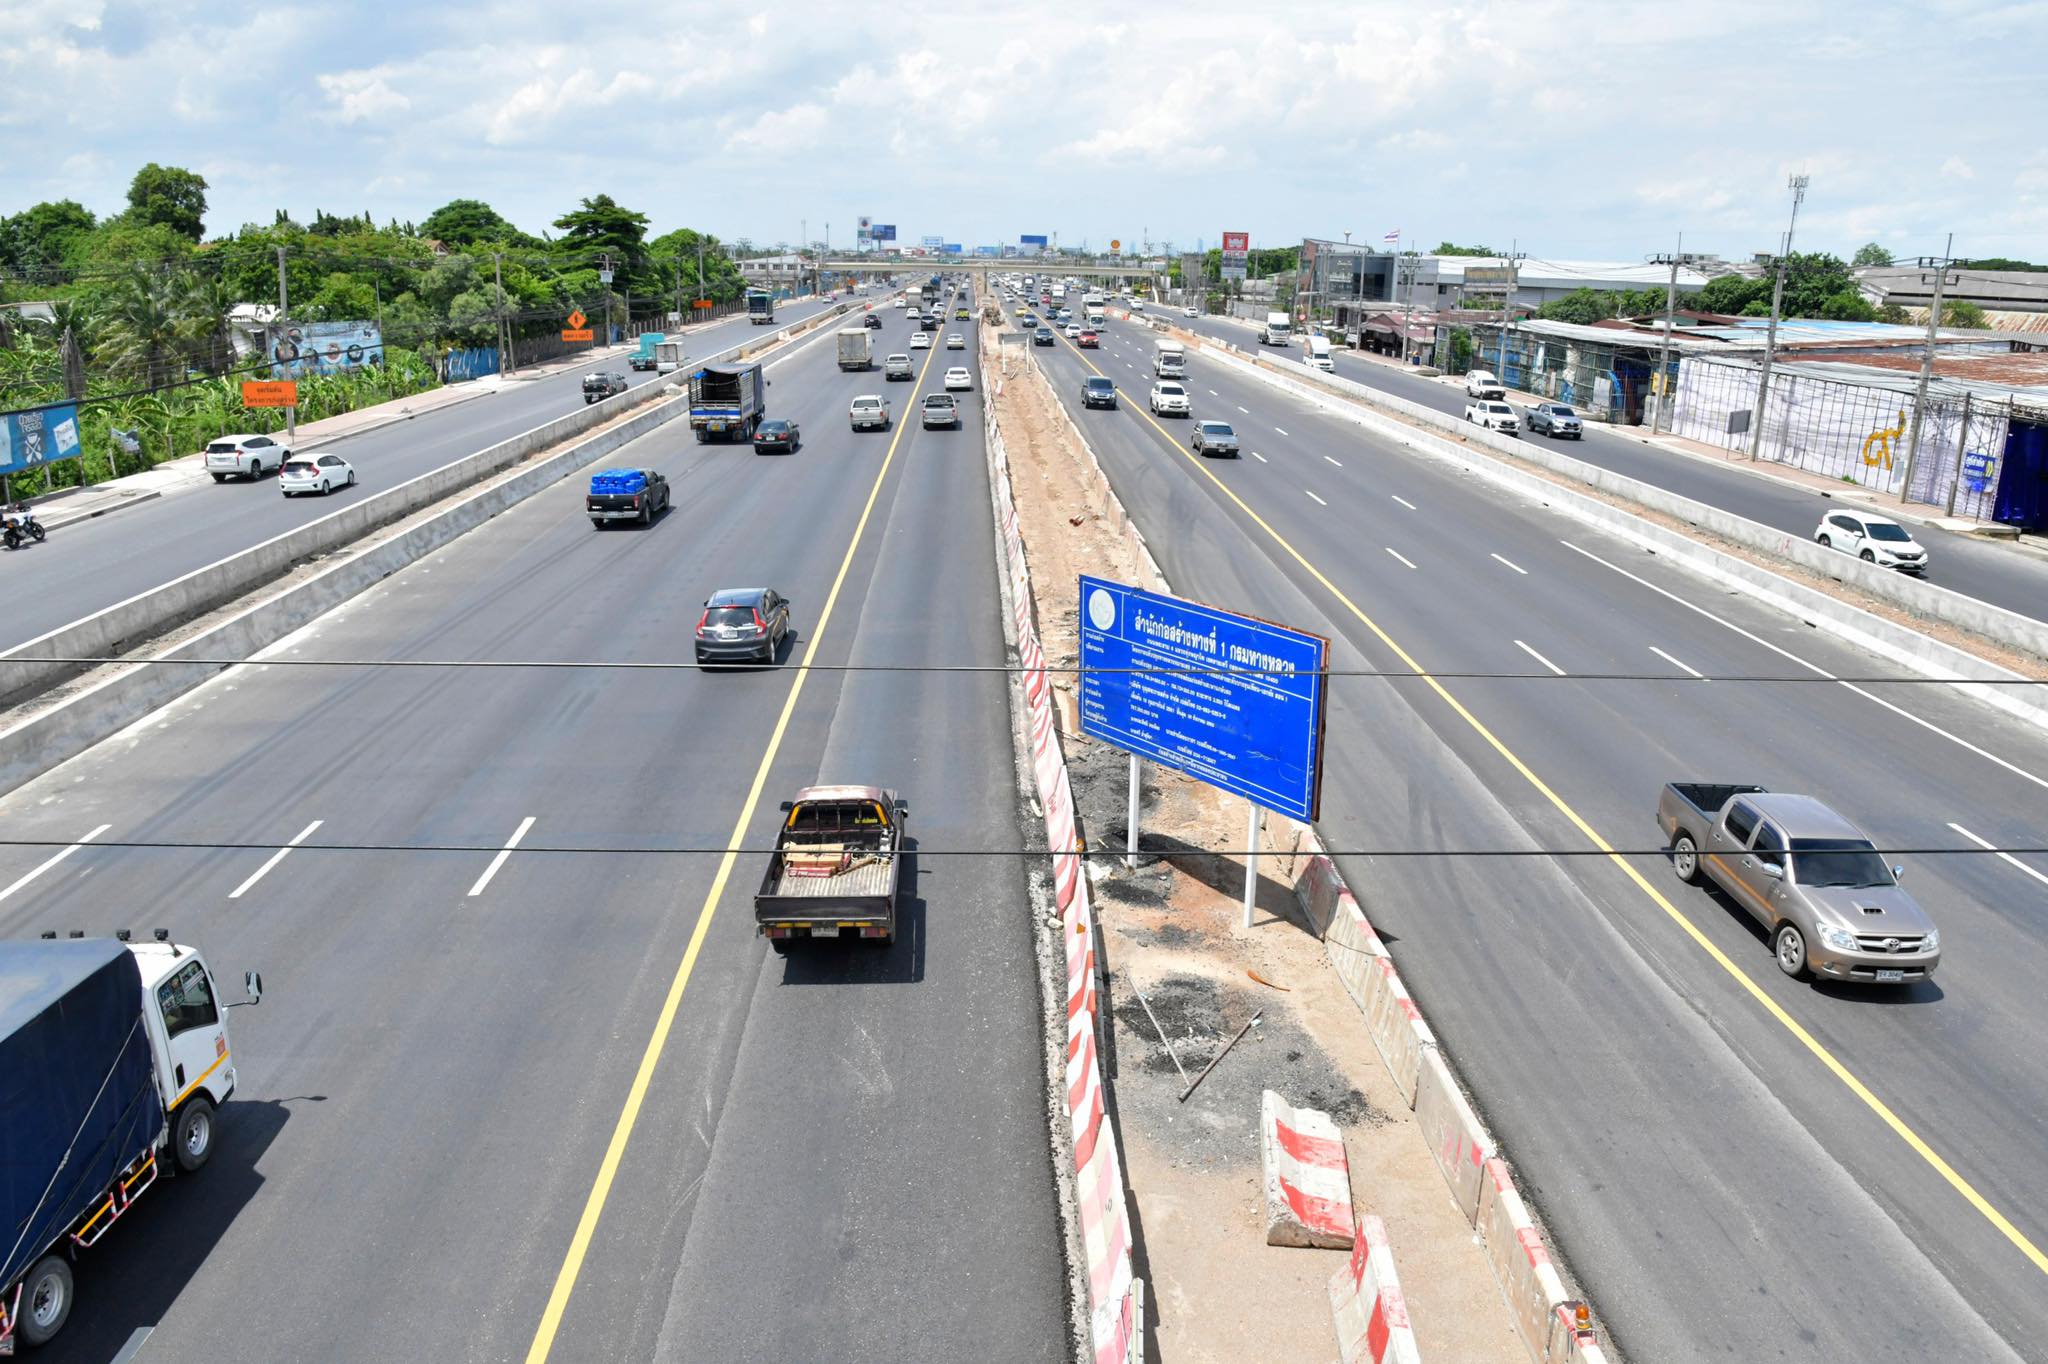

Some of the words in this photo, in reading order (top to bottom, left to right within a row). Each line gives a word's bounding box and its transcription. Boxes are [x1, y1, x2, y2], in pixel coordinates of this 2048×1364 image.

[1135, 608, 1216, 654] สำนักก่อสร้างทางที่
[1220, 640, 1225, 657] 1
[1229, 643, 1295, 679] กรมทางหลวง
